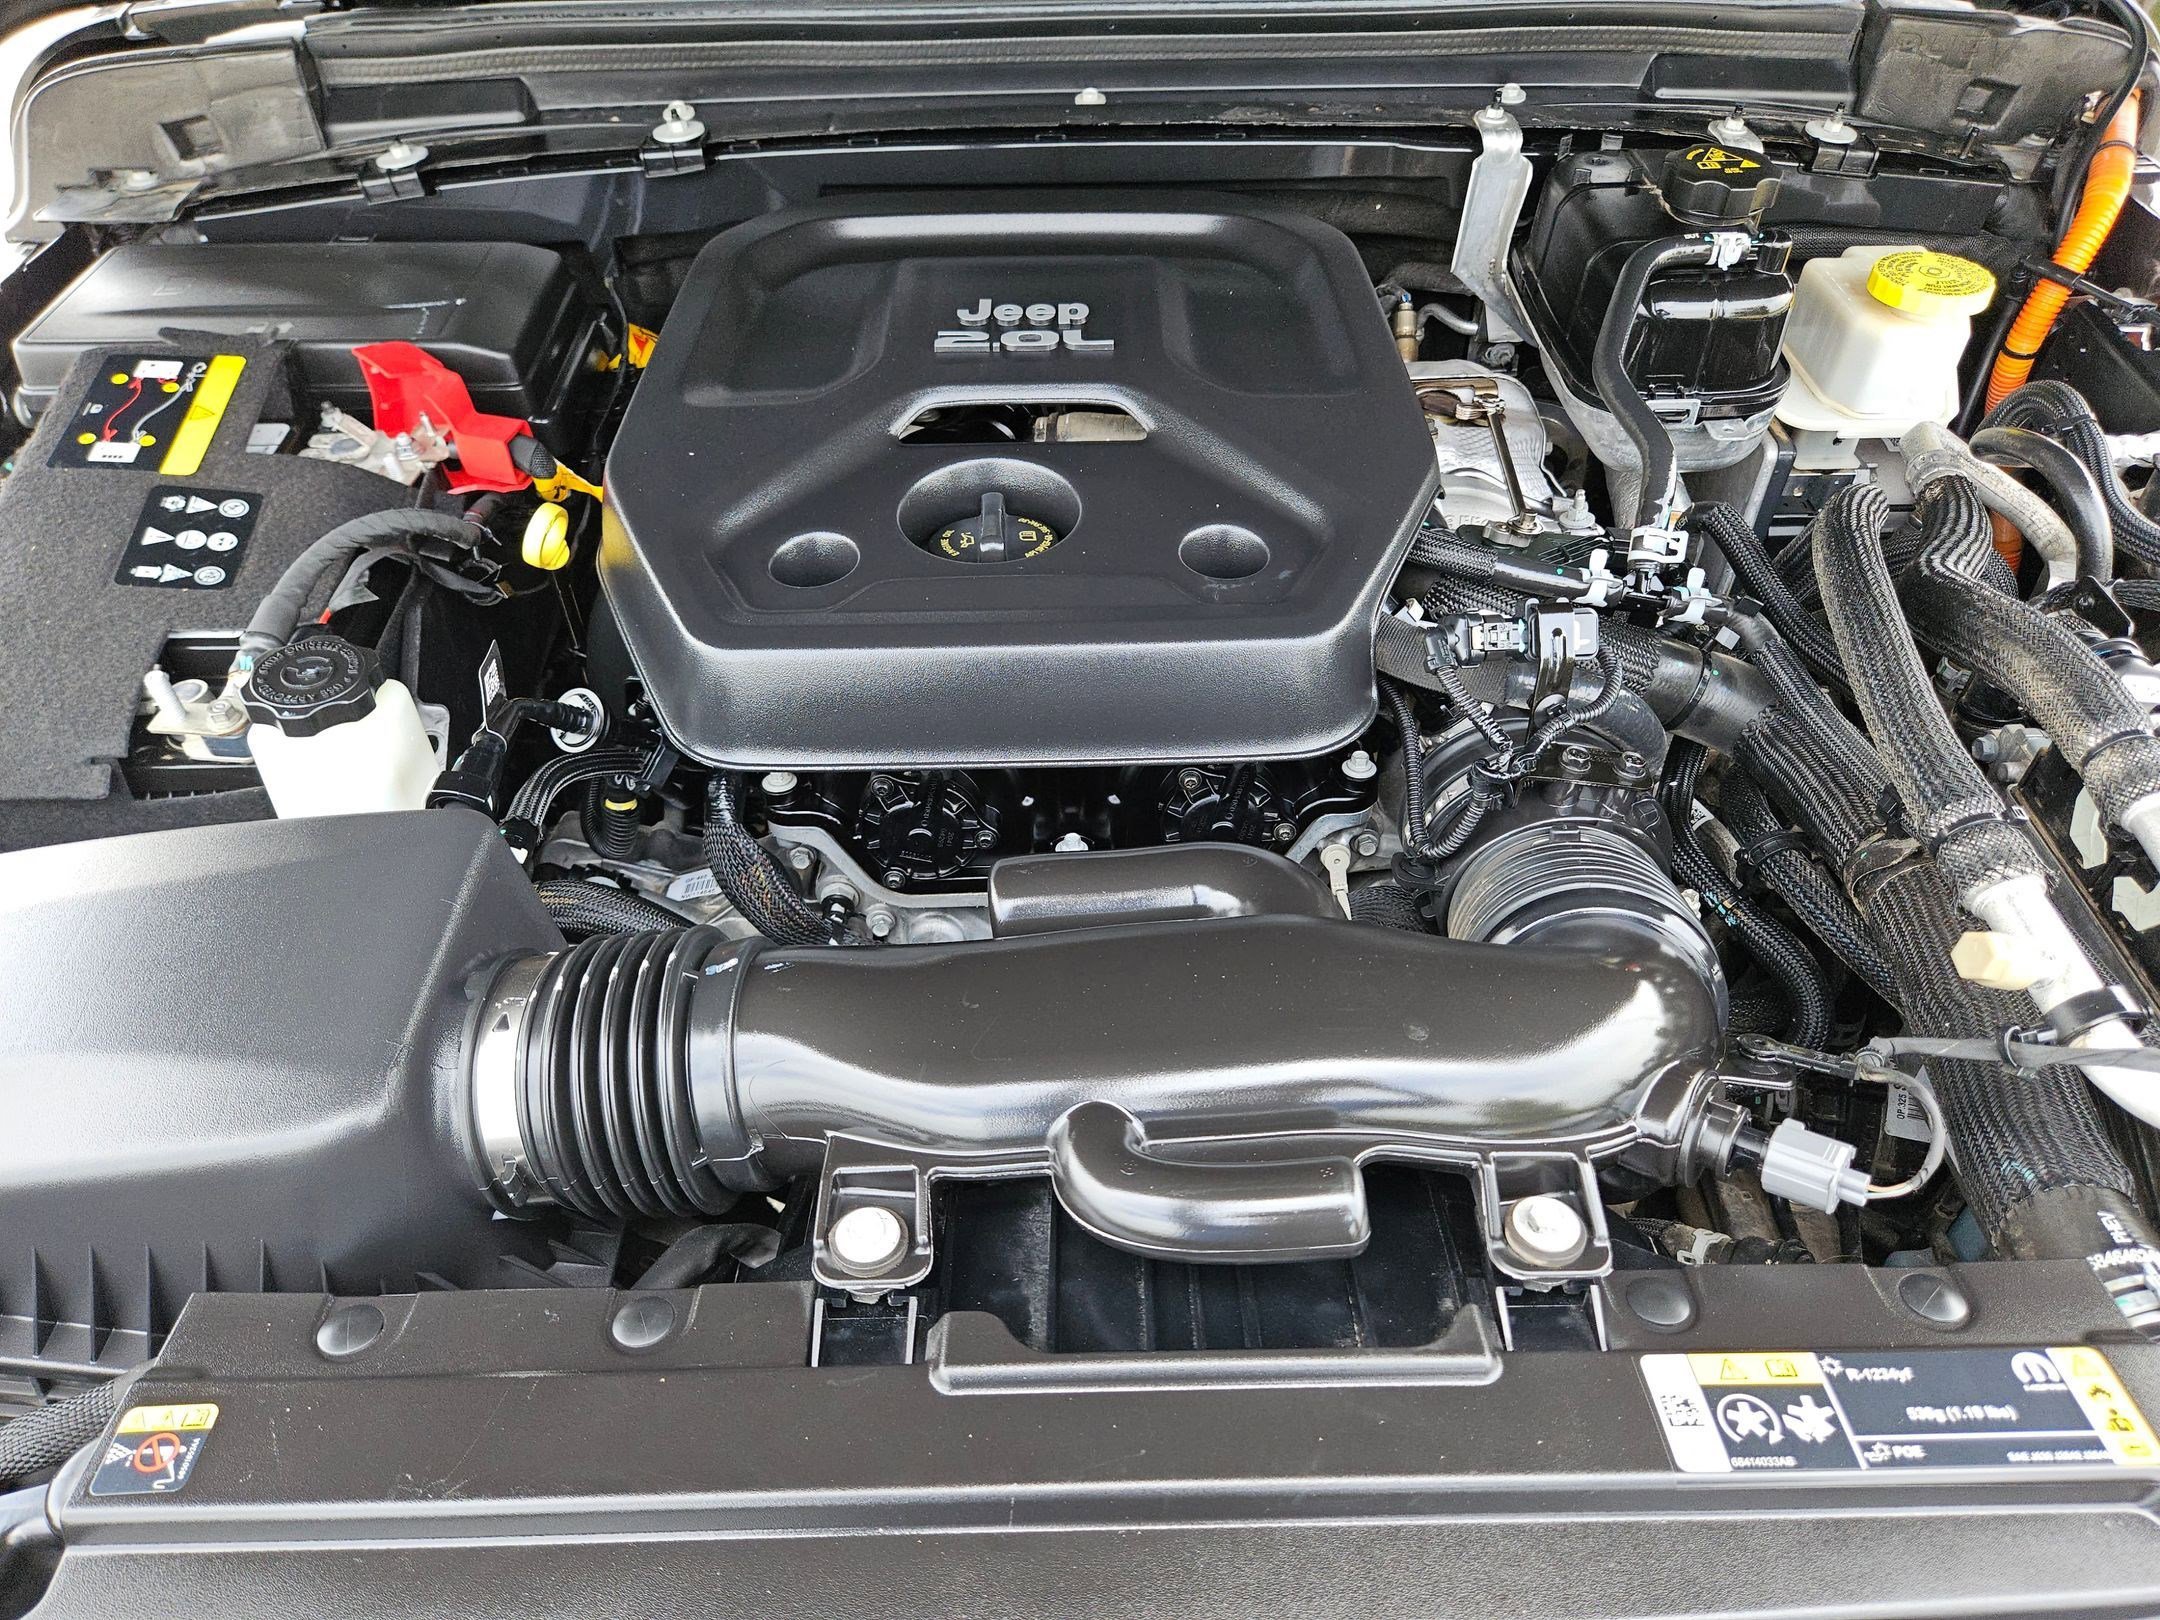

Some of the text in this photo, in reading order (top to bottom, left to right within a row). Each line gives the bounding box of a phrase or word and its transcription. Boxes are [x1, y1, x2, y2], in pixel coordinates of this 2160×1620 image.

[957, 298, 1090, 329] Jeep
[934, 330, 1115, 353] 2.0L
[2096, 1210, 2133, 1244] PHEV
